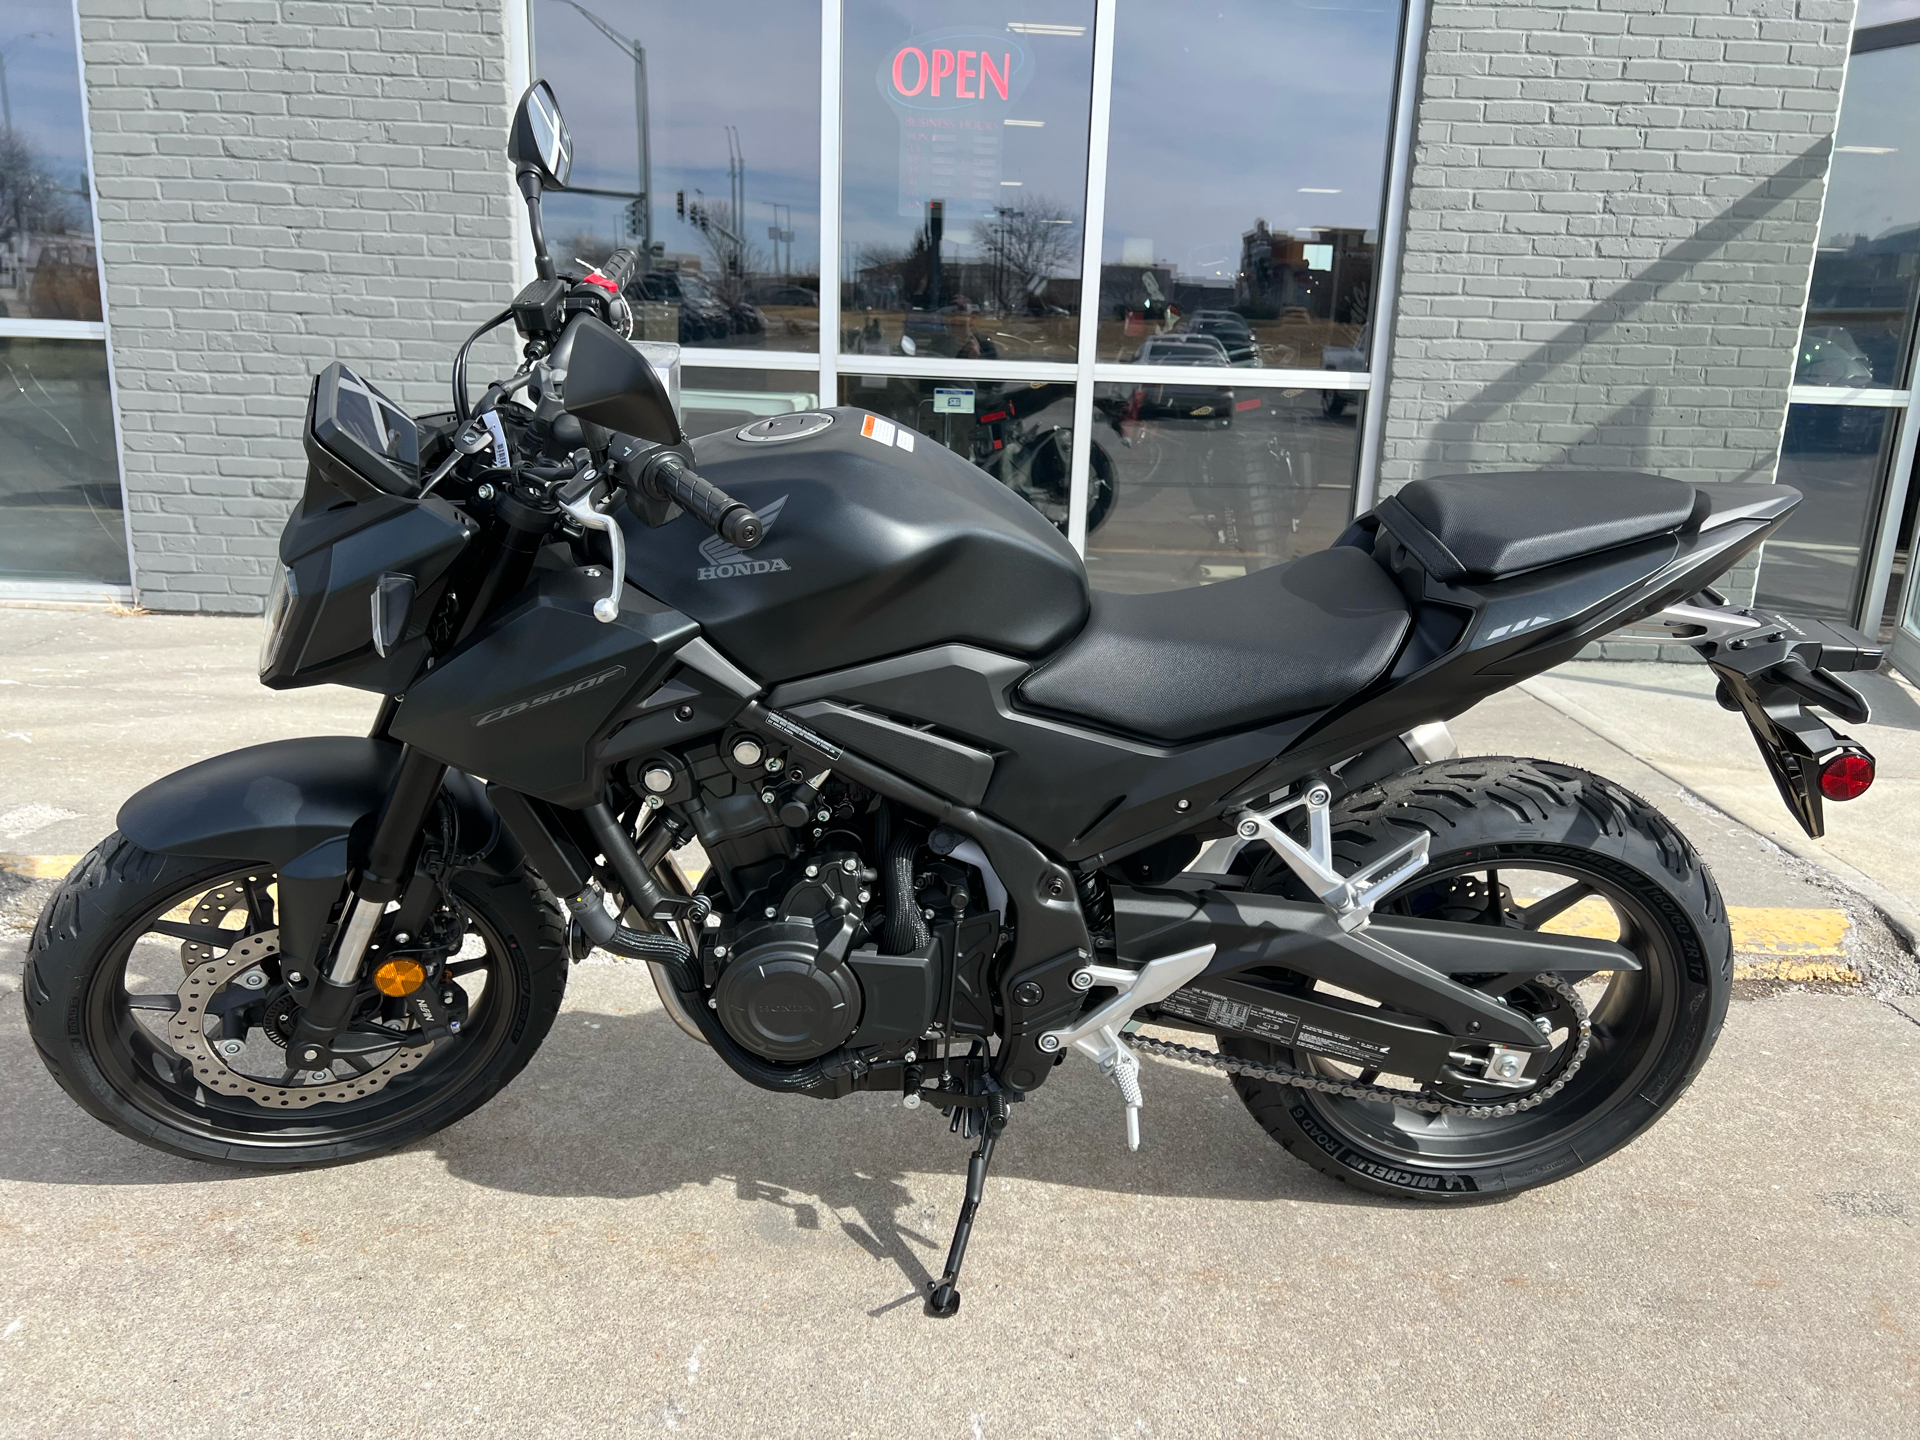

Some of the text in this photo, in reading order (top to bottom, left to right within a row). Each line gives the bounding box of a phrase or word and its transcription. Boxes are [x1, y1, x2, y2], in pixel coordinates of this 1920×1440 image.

[892, 46, 1010, 100] OPEN
[905, 117, 999, 131] BUSINESS HOURS
[697, 558, 791, 580] HONDA
[1774, 613, 1808, 637] HONDA
[476, 667, 623, 727] CB500F
[1539, 844, 1705, 980] MICHELIN 160/60 ZR 17
[69, 1007, 79, 1032] ROAD
[759, 1005, 816, 1013] HONDA
[1293, 1107, 1440, 1189] MICHELIN ROAD 6
